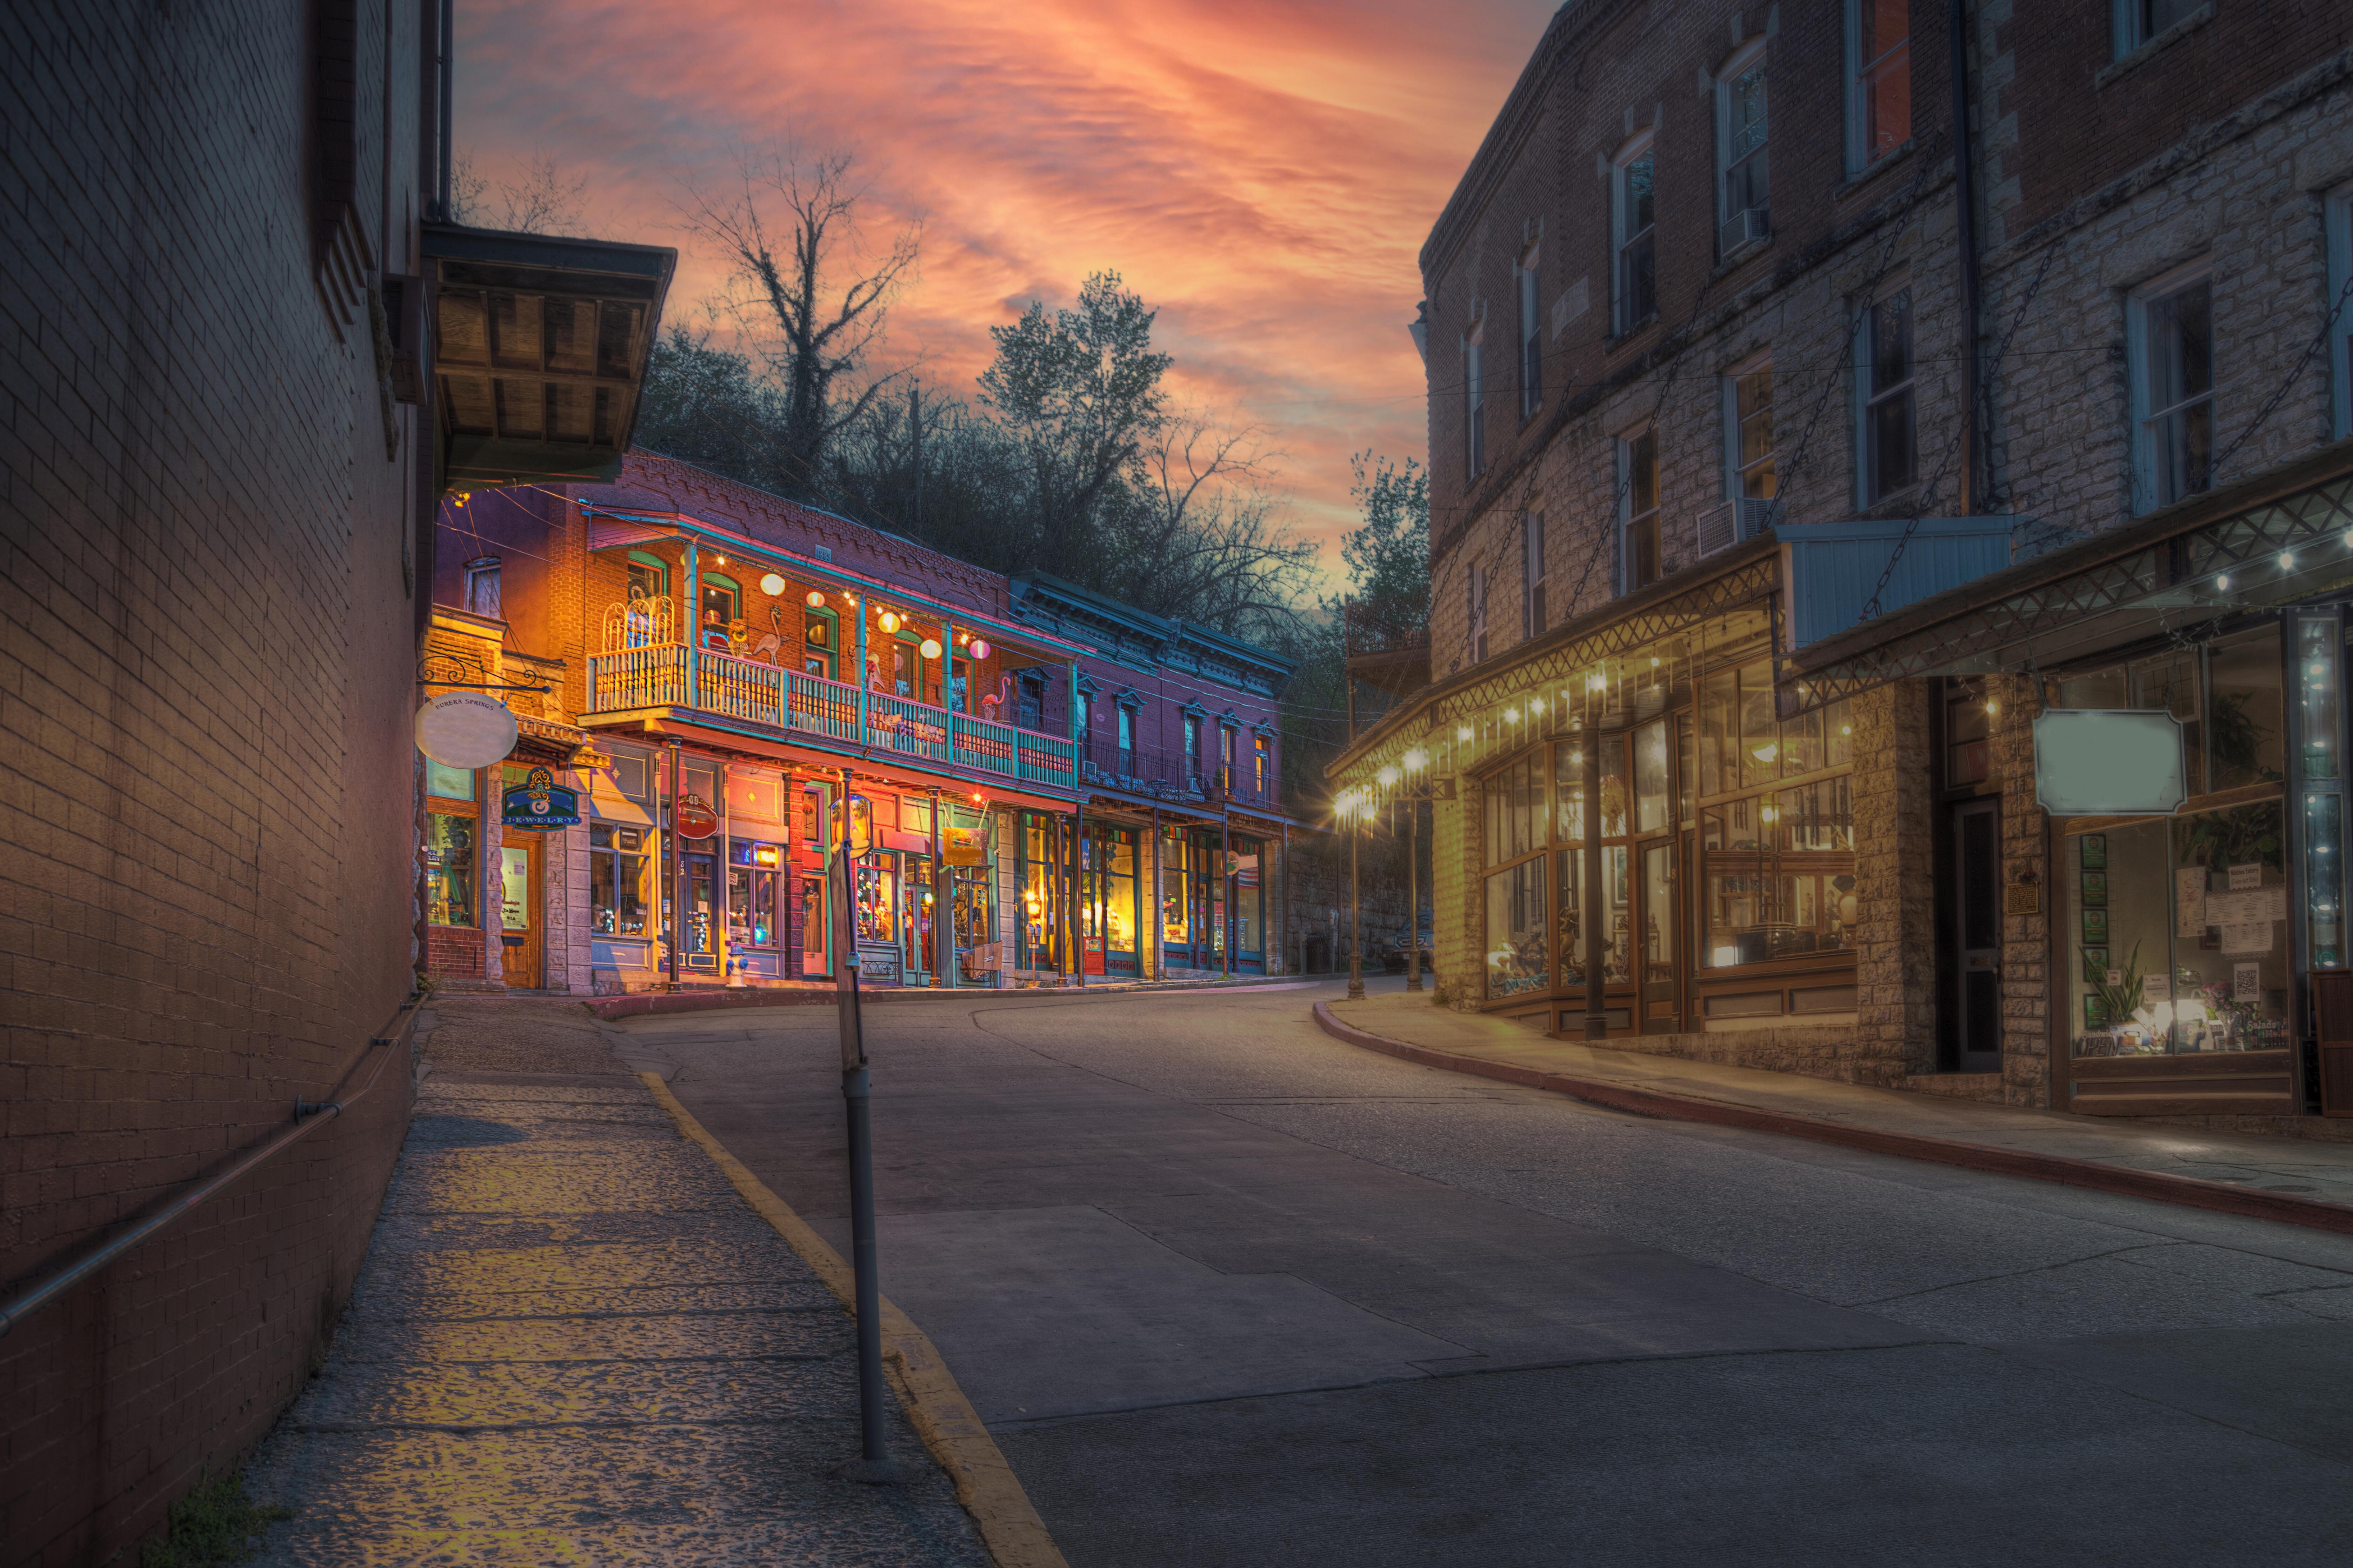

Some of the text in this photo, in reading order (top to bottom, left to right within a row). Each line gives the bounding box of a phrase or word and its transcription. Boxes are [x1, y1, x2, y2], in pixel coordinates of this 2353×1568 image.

[435, 699, 494, 711] EUREKA SPRINGS
[2247, 1019, 2277, 1032] Salads
